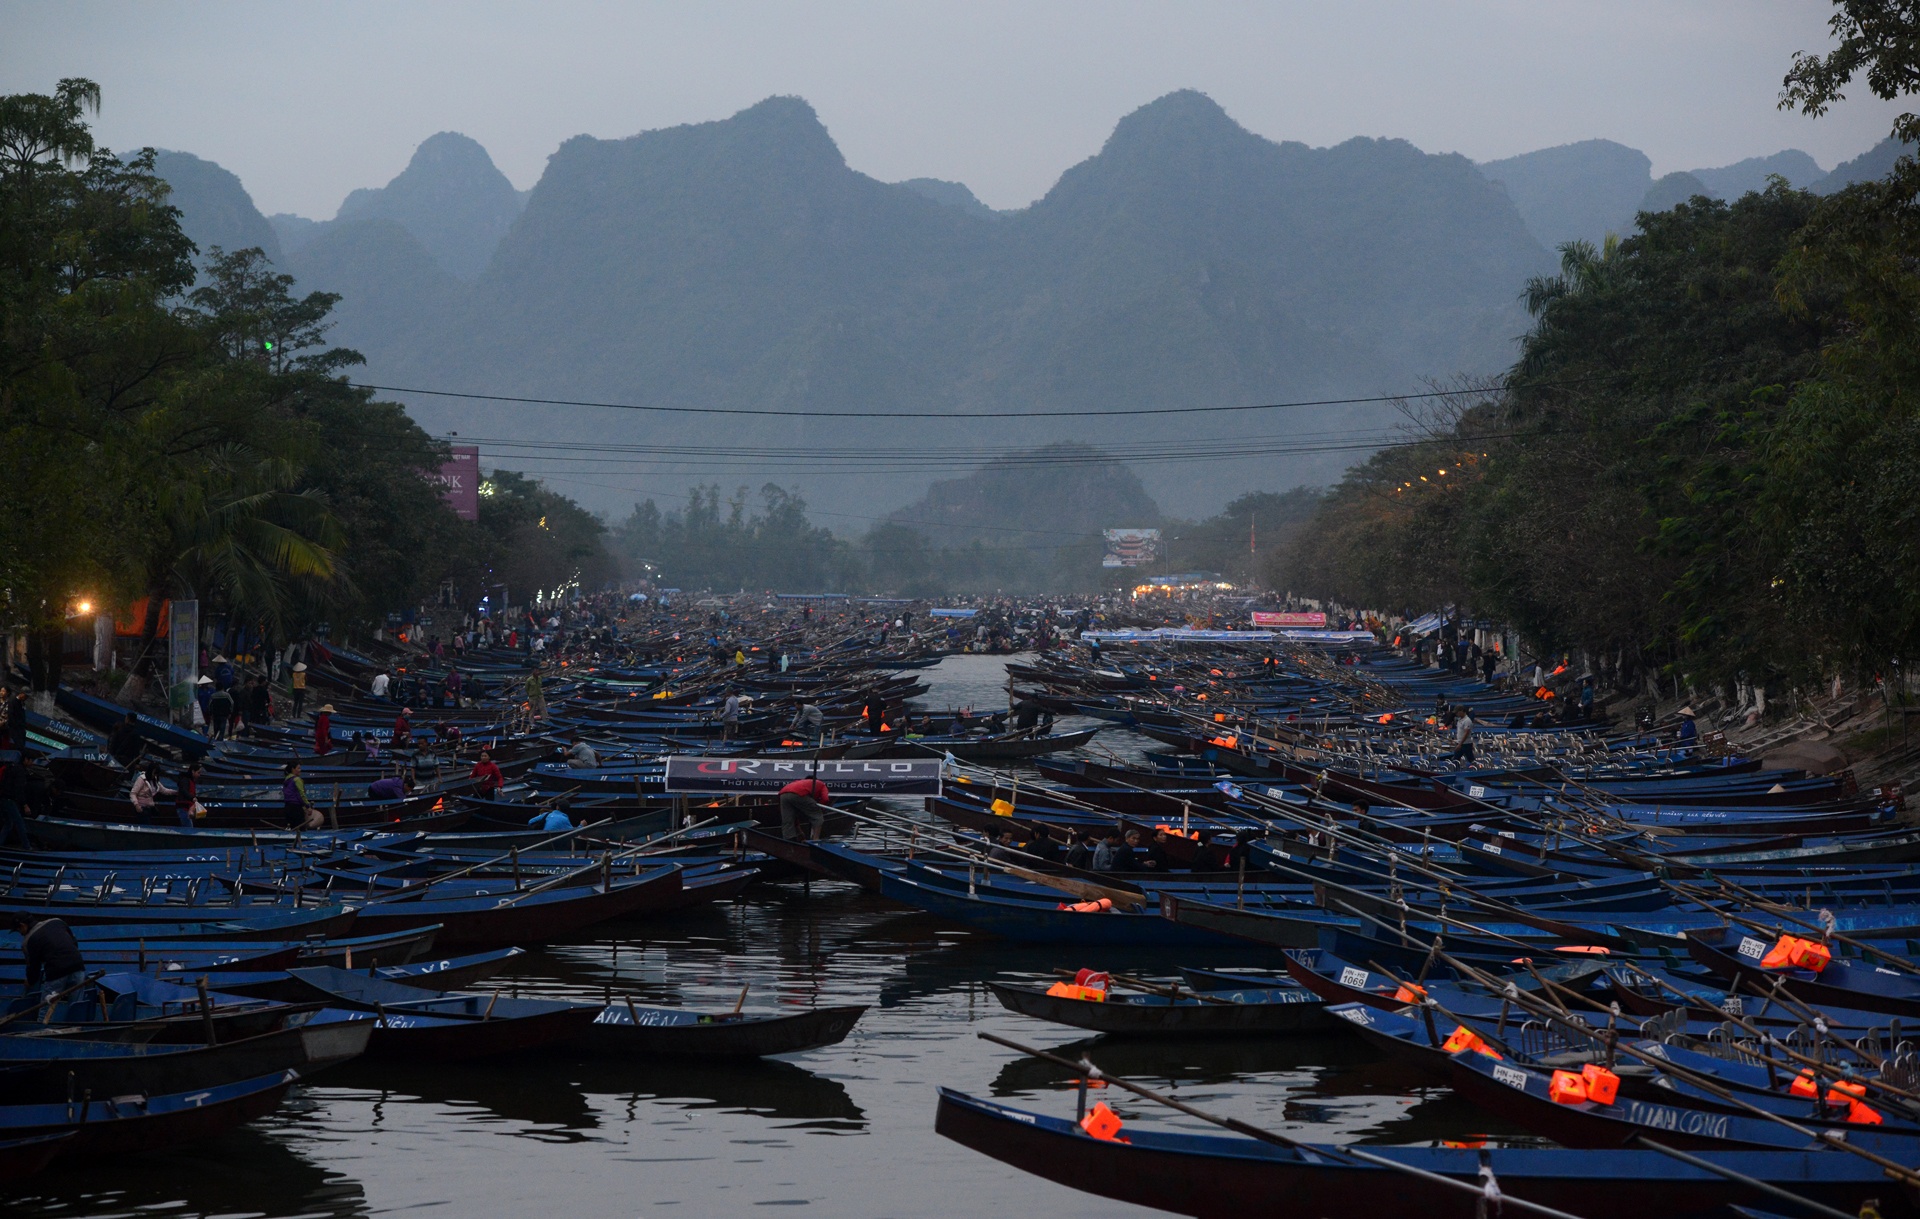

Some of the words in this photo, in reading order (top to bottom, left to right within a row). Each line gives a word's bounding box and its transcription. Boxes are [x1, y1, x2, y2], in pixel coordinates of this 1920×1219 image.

[773, 761, 912, 772] RULLO
[747, 780, 779, 788] TRANG
[849, 780, 877, 789] CÁCH
[1739, 944, 1762, 957] 3331
[1744, 938, 1764, 951] HN-HS
[1345, 968, 1366, 979] HN-HS
[1343, 975, 1365, 987] 1069
[1496, 1068, 1525, 1083] HN-HS
